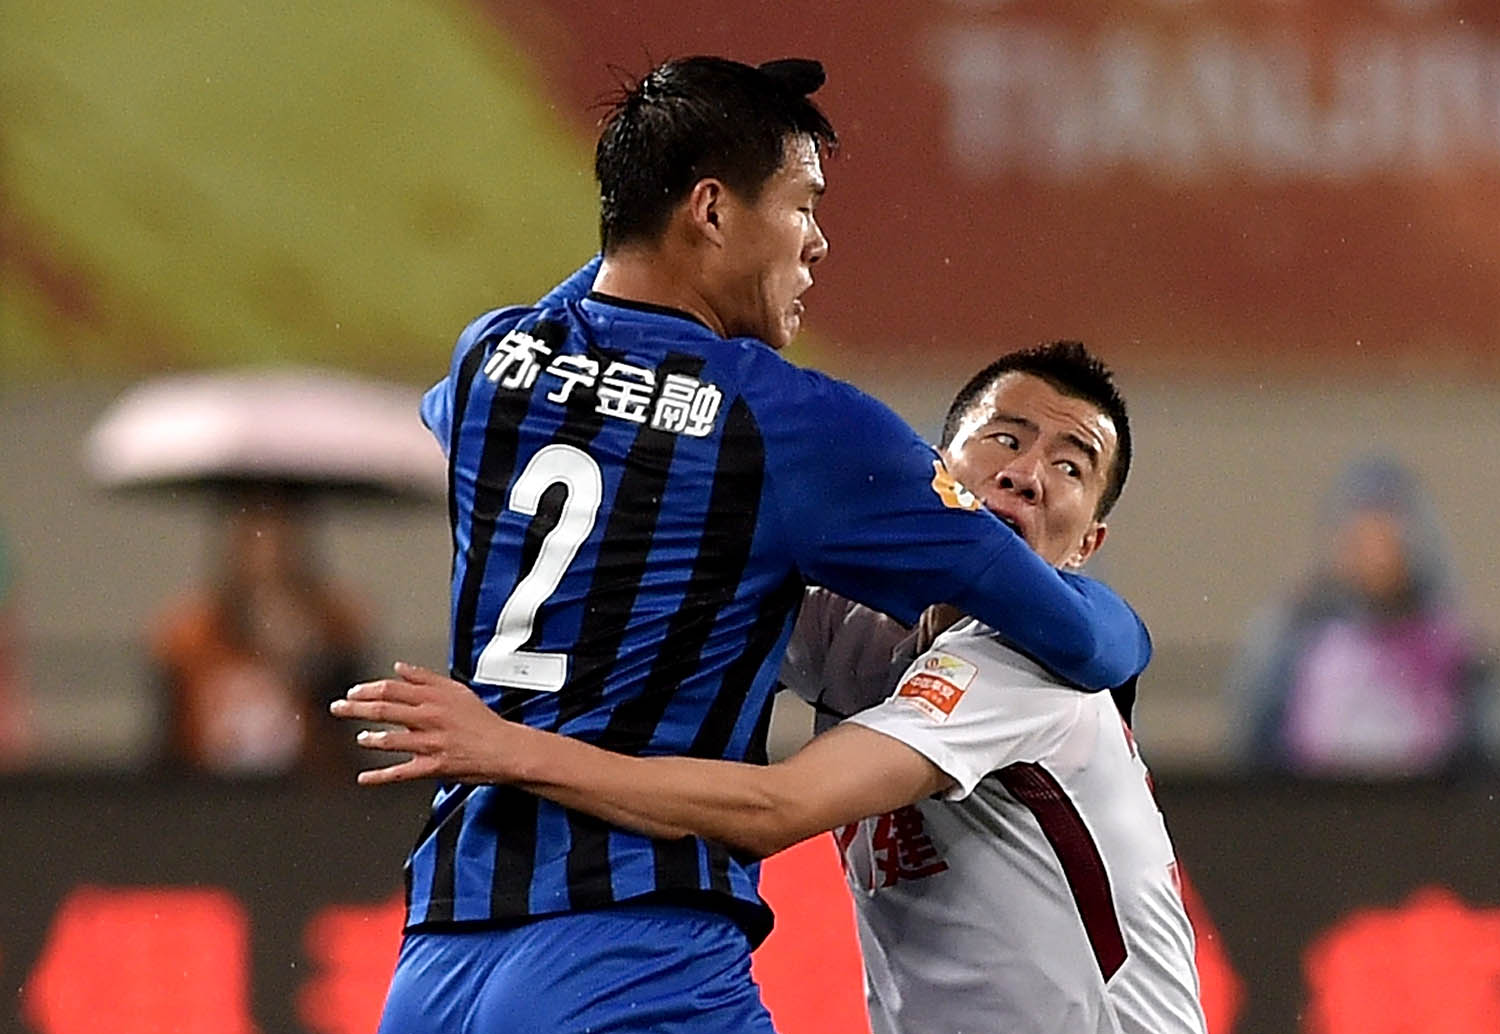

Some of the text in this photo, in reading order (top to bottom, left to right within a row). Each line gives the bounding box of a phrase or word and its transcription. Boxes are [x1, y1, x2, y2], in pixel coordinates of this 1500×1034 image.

[484, 329, 723, 437] 苏宁金融
[473, 443, 603, 692] 2
